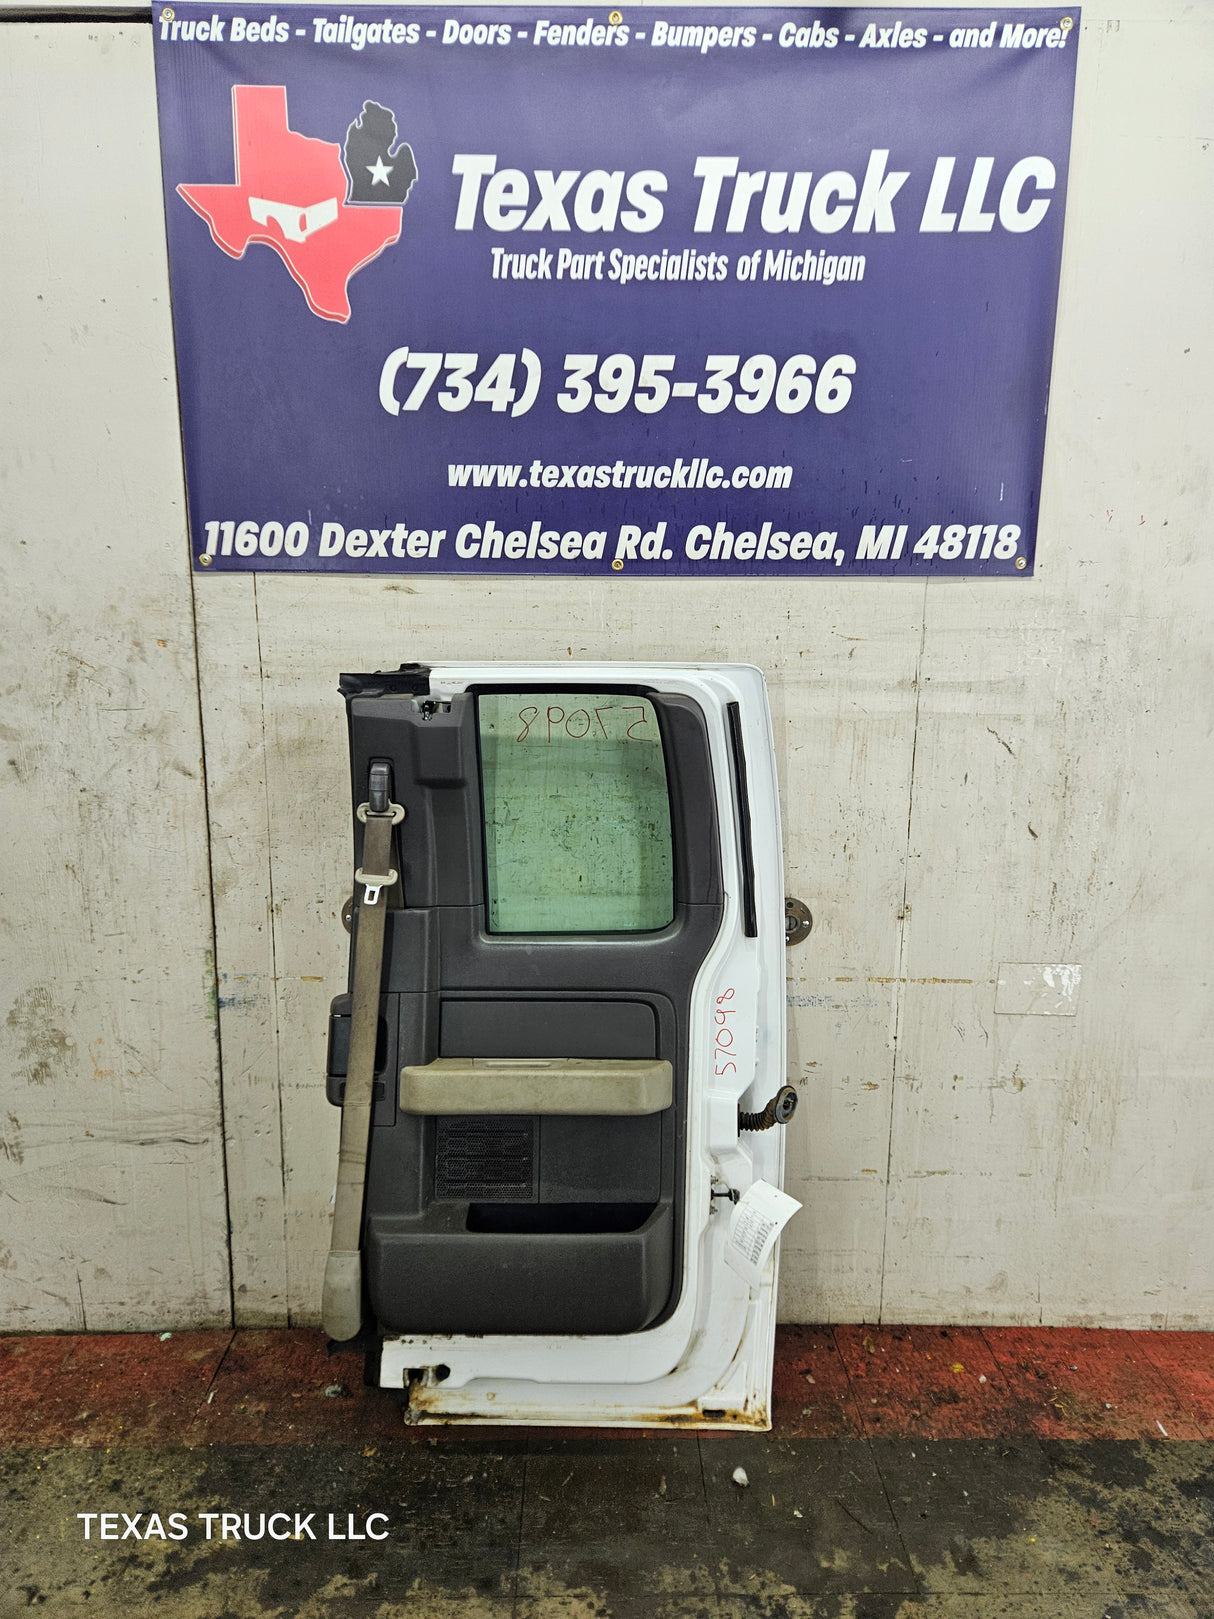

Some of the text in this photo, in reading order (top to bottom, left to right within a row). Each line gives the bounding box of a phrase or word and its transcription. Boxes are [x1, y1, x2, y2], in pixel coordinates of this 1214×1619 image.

[158, 15, 224, 42] Truck
[230, 16, 290, 42] Beds
[312, 15, 420, 50] Tailgates
[442, 20, 511, 45] Doors
[533, 19, 630, 46] Fenders
[651, 22, 756, 53] Bumpers
[778, 21, 839, 49] Cabs
[859, 22, 927, 49] Axles
[949, 22, 998, 49] and
[1000, 23, 1068, 49] More!
[452, 149, 1057, 234] Texas Truck LLC
[491, 247, 866, 285] Truck Part Specialists of Michigan
[378, 346, 857, 418] (734) 395-3966
[448, 458, 793, 489] www.texastruckllc.com
[205, 520, 1021, 566] 11600 Dexter Chelsea Rd. Chelsea, MI 48118
[714, 988, 737, 1076] 57098
